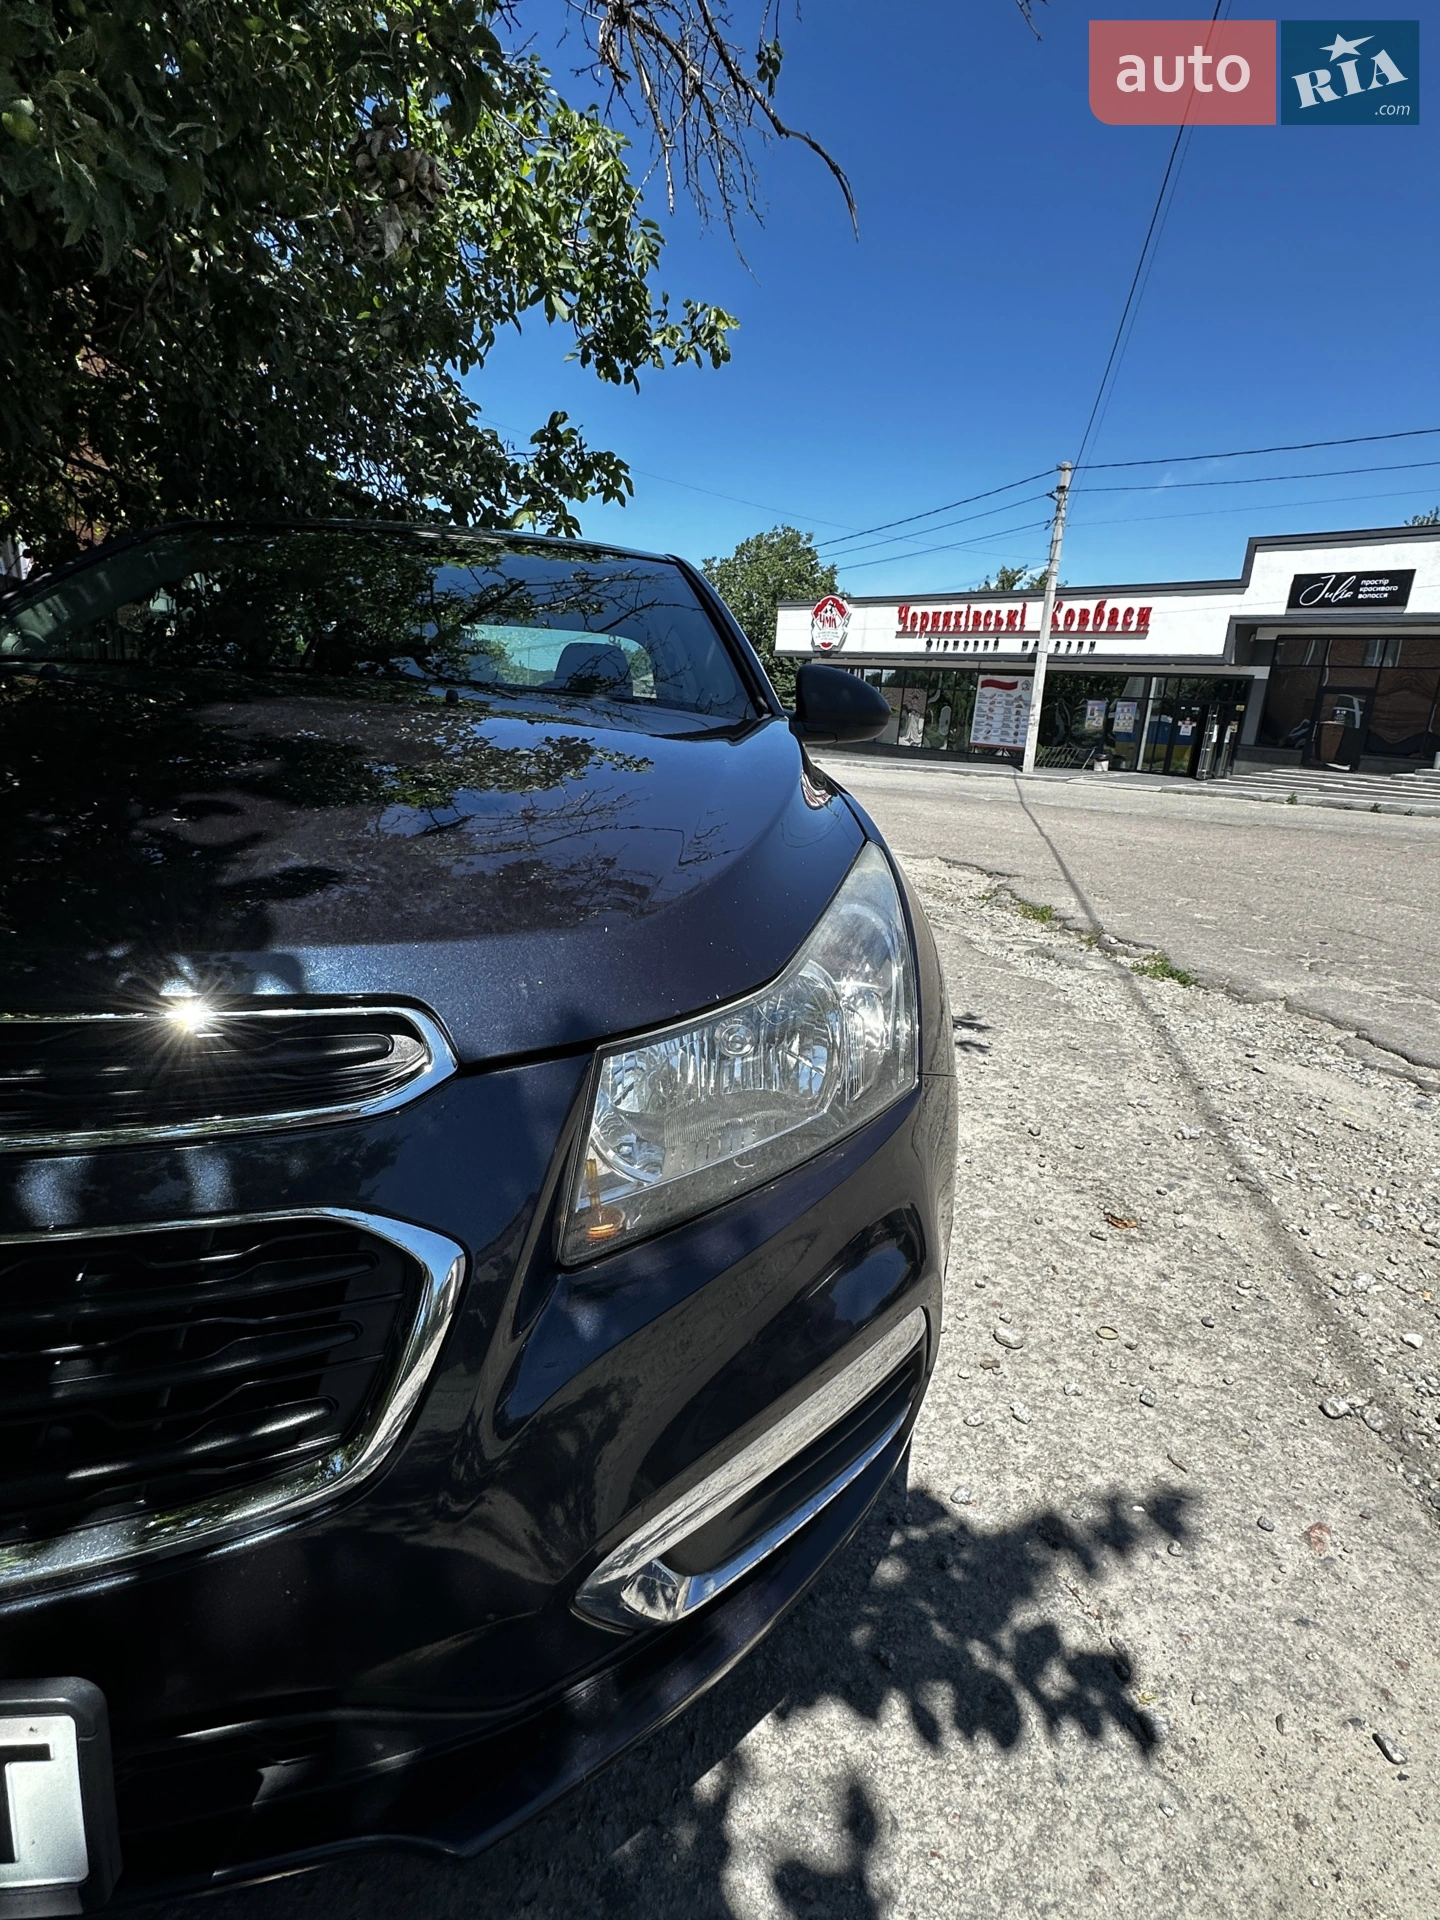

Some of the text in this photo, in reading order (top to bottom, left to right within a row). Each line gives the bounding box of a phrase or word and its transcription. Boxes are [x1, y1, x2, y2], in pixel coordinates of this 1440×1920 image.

[1361, 578, 1389, 586] простір
[1299, 574, 1357, 606] Julia
[1359, 585, 1398, 593] красивого
[897, 602, 1027, 633] Черняхівські
[1022, 640, 1096, 651] маазин
